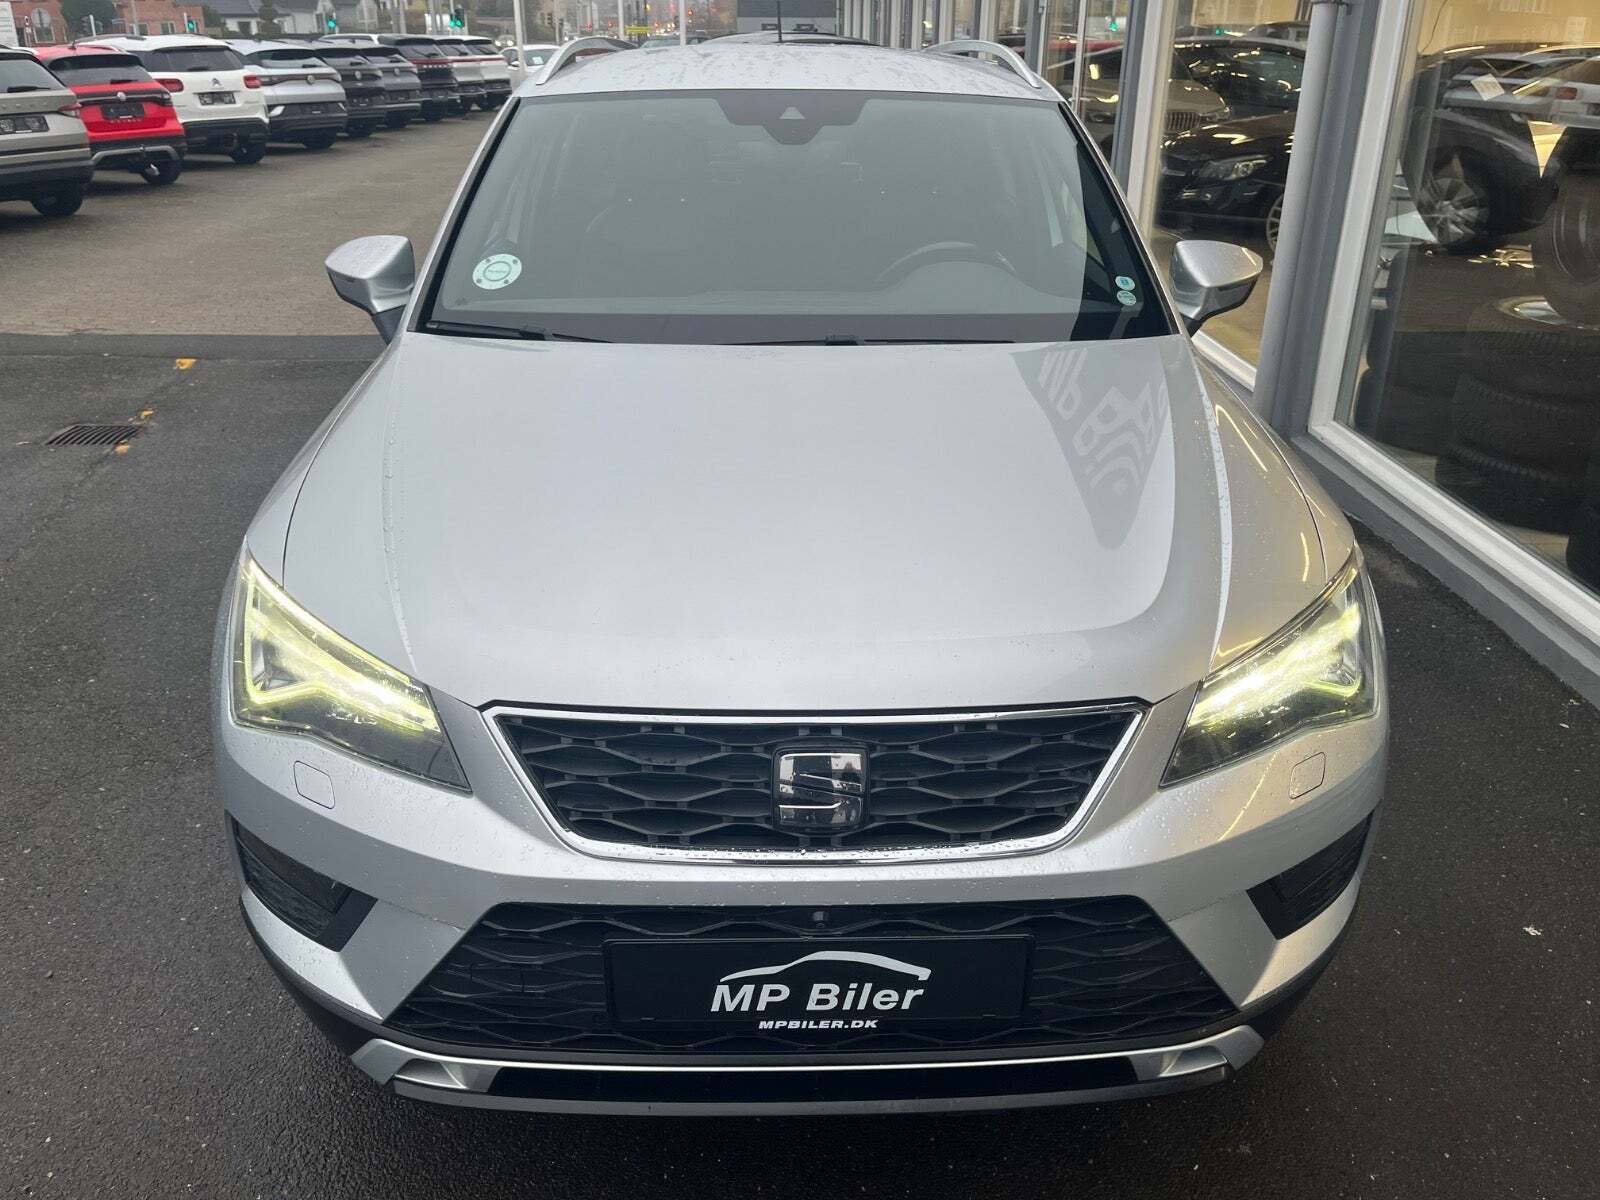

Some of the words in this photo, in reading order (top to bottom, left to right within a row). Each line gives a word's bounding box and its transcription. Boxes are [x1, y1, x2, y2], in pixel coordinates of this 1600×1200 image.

[710, 983, 790, 1012] MP
[806, 982, 924, 1011] Biler
[758, 1019, 879, 1030] MPBILER.DK
